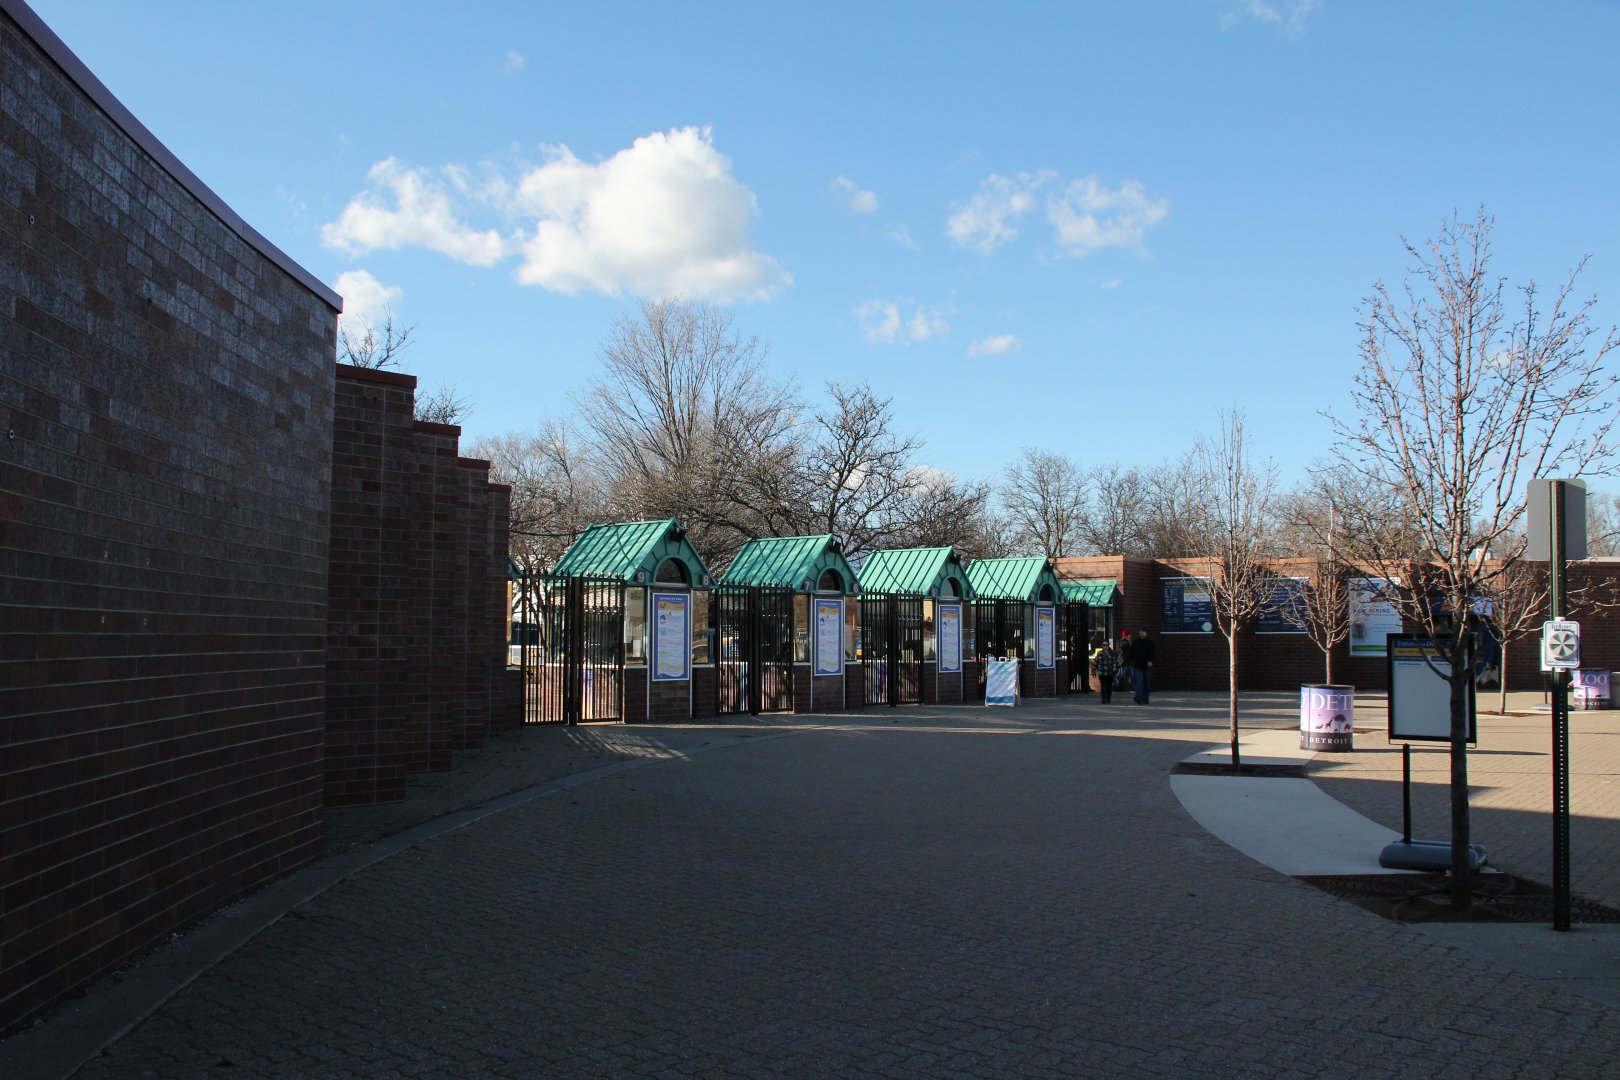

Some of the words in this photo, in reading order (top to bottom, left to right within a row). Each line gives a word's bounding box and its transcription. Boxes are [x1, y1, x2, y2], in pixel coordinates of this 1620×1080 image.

[637, 571, 644, 583] 9
[703, 575, 709, 585] 8
[804, 581, 810, 590] 7
[853, 583, 859, 592] 6
